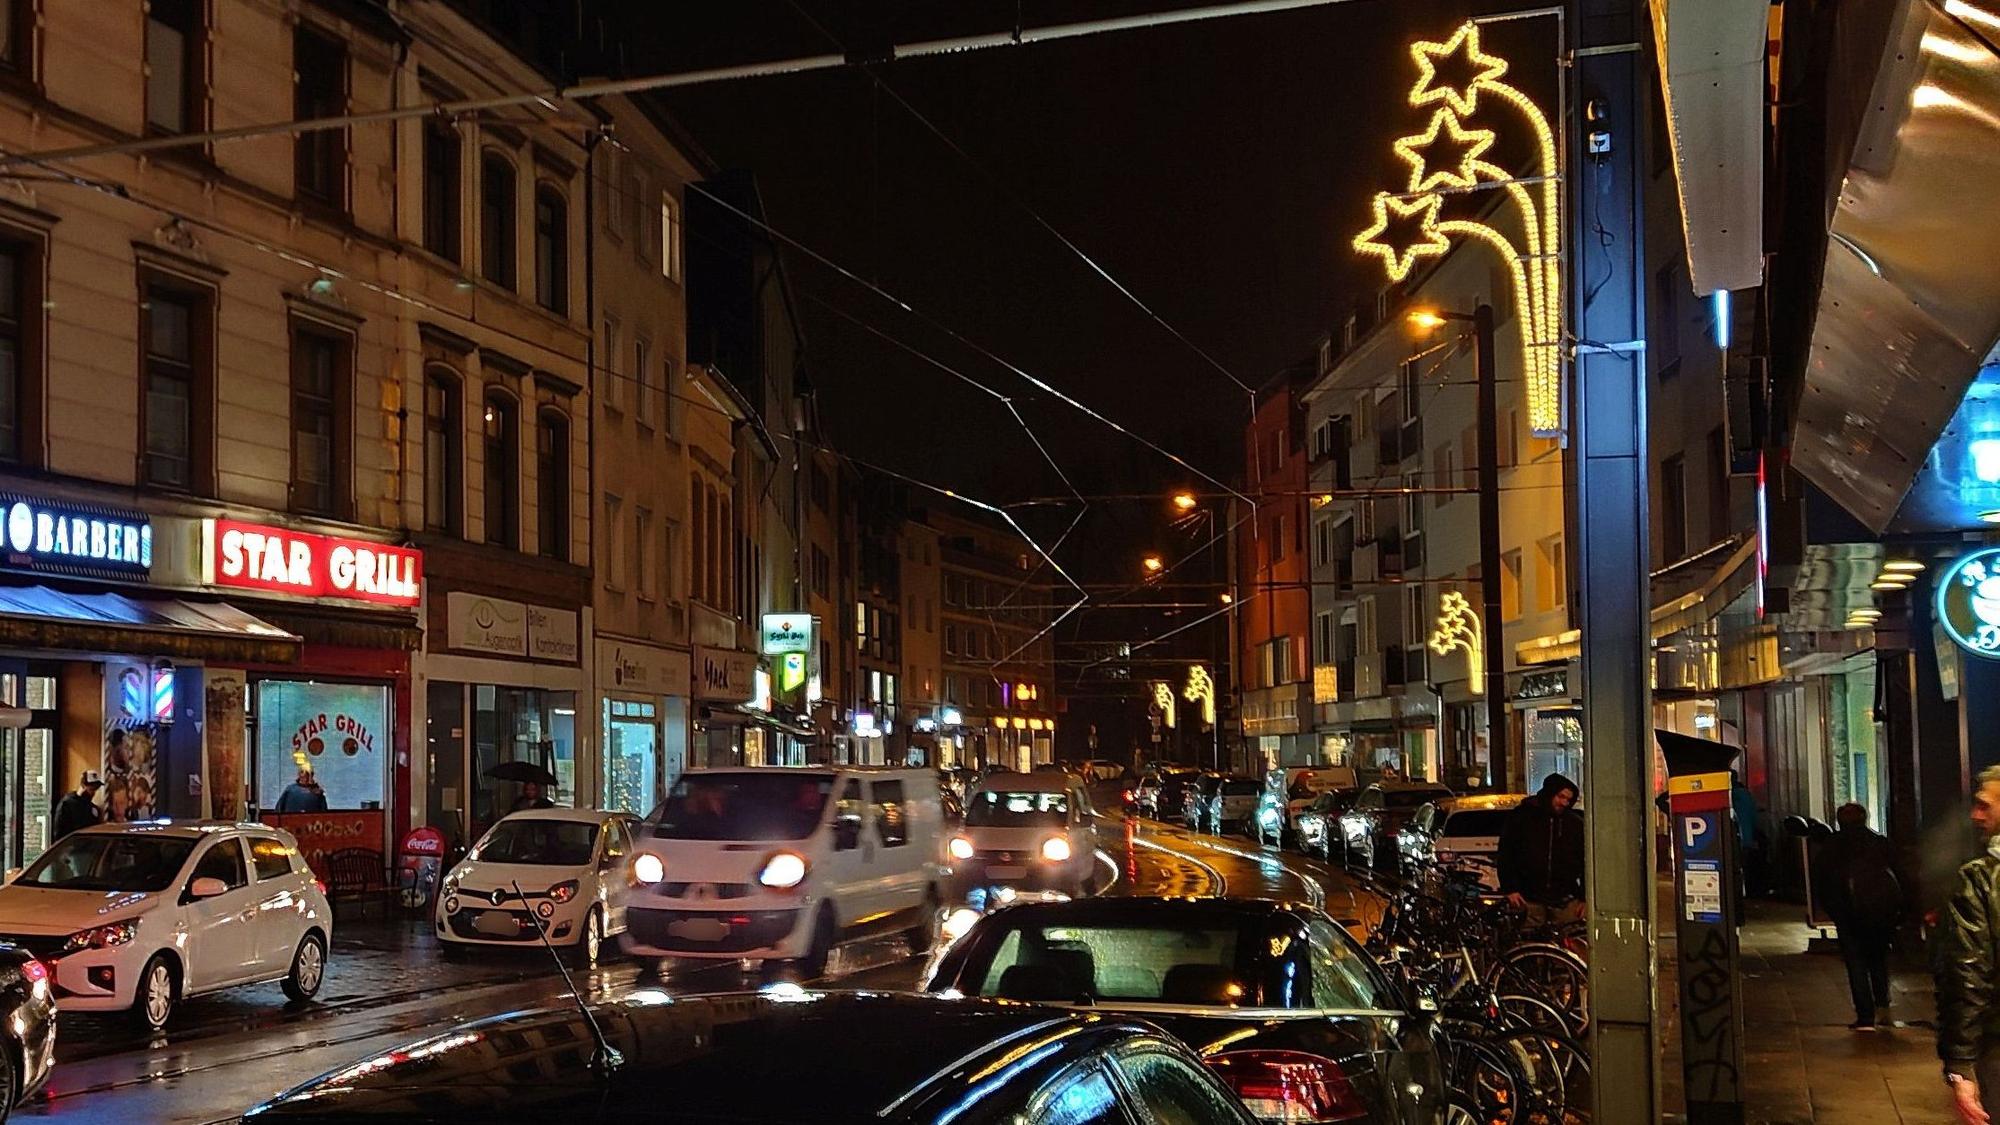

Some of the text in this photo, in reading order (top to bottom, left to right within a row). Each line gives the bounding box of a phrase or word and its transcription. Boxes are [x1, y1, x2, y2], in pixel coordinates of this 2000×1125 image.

[36, 512, 139, 564] BARBER
[222, 529, 419, 597] STAR GRILL
[292, 713, 373, 753] STAR GRILL
[1684, 816, 1708, 847] P
